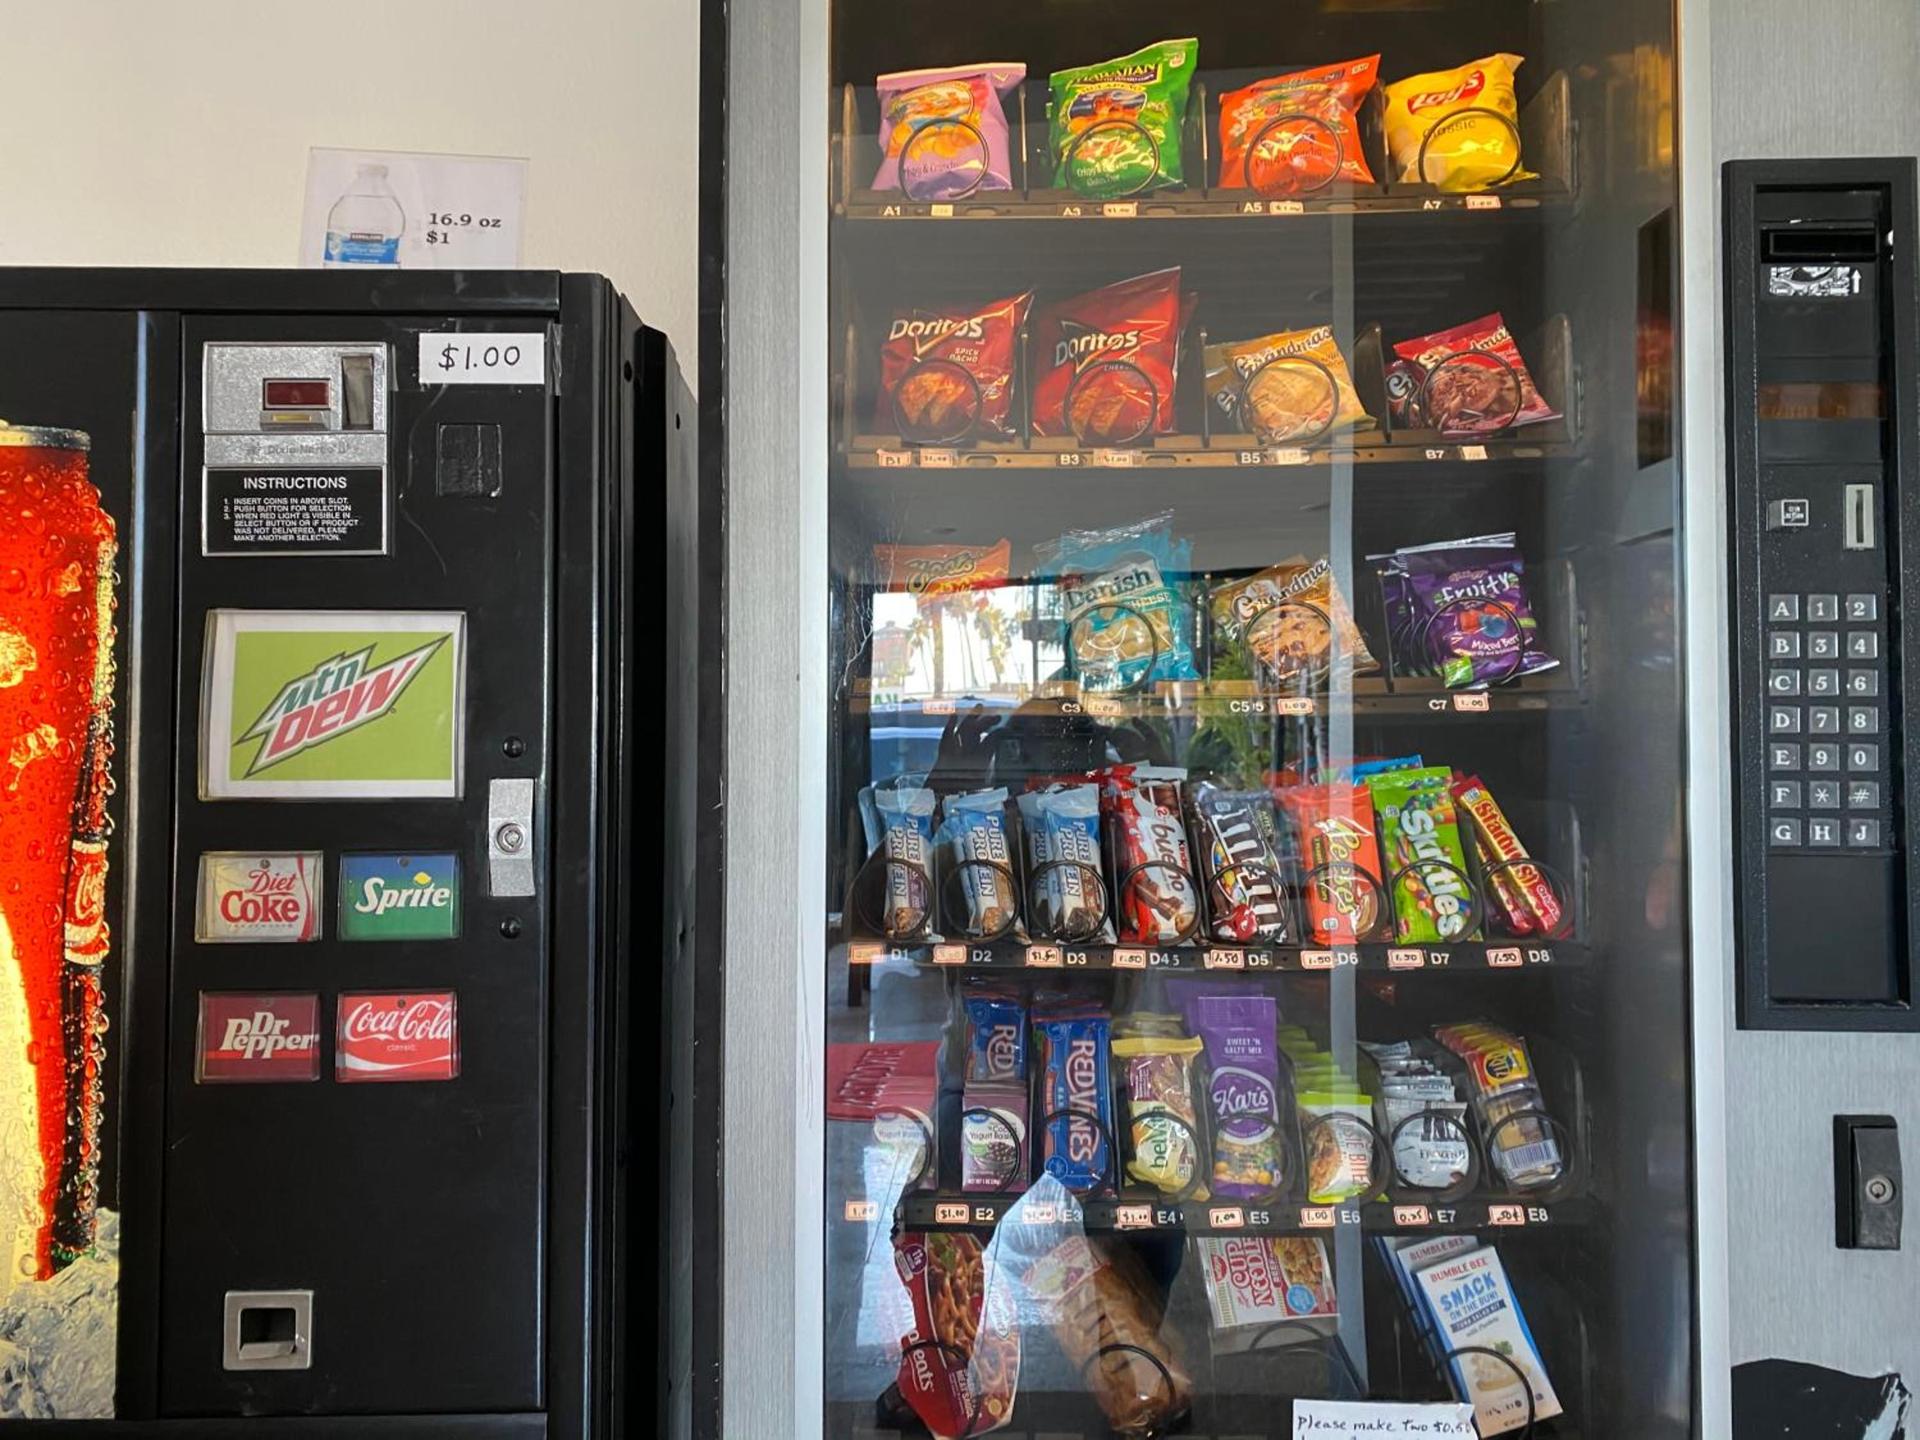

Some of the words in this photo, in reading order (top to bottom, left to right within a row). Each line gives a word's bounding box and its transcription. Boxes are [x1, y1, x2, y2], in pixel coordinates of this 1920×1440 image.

[1411, 71, 1480, 110] Lay's
[883, 206, 900, 216] A1
[1063, 207, 1081, 216] A3
[1244, 203, 1262, 213] A5
[1424, 200, 1442, 210] A7
[429, 213, 472, 227] 16.9
[479, 217, 502, 228] oz
[426, 230, 450, 245] $1
[889, 318, 983, 341] Doritos
[1055, 330, 1140, 367] Doritos
[439, 344, 521, 371] $1.00
[1060, 454, 1080, 465] B3
[1241, 452, 1261, 464] B5
[1425, 450, 1444, 460] B7
[243, 477, 348, 489] INSTRUCTIONS
[234, 519, 264, 527] SELECT
[266, 519, 297, 527] BUTTON
[299, 519, 311, 527] OR
[321, 519, 359, 527] PRODUCT
[1067, 566, 1152, 607] Danish
[1774, 602, 1790, 616] A
[1816, 602, 1825, 616] 1
[1854, 602, 1865, 616] 2
[1776, 639, 1790, 653] B
[1815, 638, 1827, 653] 3
[1855, 639, 1866, 653] 4
[1775, 676, 1791, 690] C
[1816, 676, 1828, 690] 5
[1855, 676, 1866, 690] 6
[1062, 703, 1081, 713] C3
[1230, 702, 1249, 712] C5
[1429, 700, 1447, 710] C7
[1775, 714, 1790, 728] D
[1816, 714, 1827, 728] 7
[1854, 714, 1866, 728] 8
[1776, 751, 1790, 765] E
[1816, 751, 1828, 765] 9
[1855, 751, 1866, 765] 0
[1776, 788, 1790, 802] F
[905, 817, 920, 861] PURE
[986, 815, 1004, 859] PURE
[1775, 826, 1792, 840] G
[1814, 826, 1831, 840] H
[1856, 826, 1867, 840] J
[1073, 821, 1090, 862] PURE
[1474, 801, 1539, 887] Starbust
[891, 826, 907, 897] PROEIN
[972, 826, 995, 897] PROEIN
[1060, 827, 1080, 897] PROEIN
[1151, 824, 1185, 892] bueno
[1400, 809, 1465, 936] Skittles
[246, 870, 297, 894] Diet
[355, 877, 451, 915] Sprite
[220, 890, 300, 923] Coke
[891, 949, 909, 962] D1
[972, 950, 993, 963] D2
[1066, 952, 1087, 966] D3
[1150, 951, 1169, 966] D4
[1248, 953, 1269, 966] D5
[1338, 953, 1358, 965] D6
[1431, 952, 1450, 965] D7
[1529, 950, 1550, 963] D8
[250, 1011, 290, 1035] Dr
[219, 1018, 320, 1060] Pepper
[1226, 1038, 1250, 1046] SWEET
[1072, 1039, 1096, 1088] RED
[1212, 1086, 1269, 1115] Kar's
[1070, 1088, 1097, 1163] VINES
[975, 1207, 994, 1220] E2
[1063, 1209, 1081, 1222] E3
[1157, 1211, 1176, 1224] E4
[1251, 1211, 1269, 1224] E5
[1341, 1211, 1361, 1224] E6
[1437, 1210, 1456, 1224] E7
[1529, 1208, 1548, 1222] E8
[1409, 1242, 1448, 1260] BUMBLE
[1447, 1238, 1464, 1249] BEE
[1226, 1241, 1251, 1288] CUP
[1430, 1264, 1468, 1282] BUMBLE
[1468, 1257, 1489, 1268] BEE
[1440, 1271, 1497, 1312] SNACK
[1449, 1310, 1462, 1320] ON
[1462, 1300, 1478, 1313] THE
[1354, 1419, 1396, 1432] make
